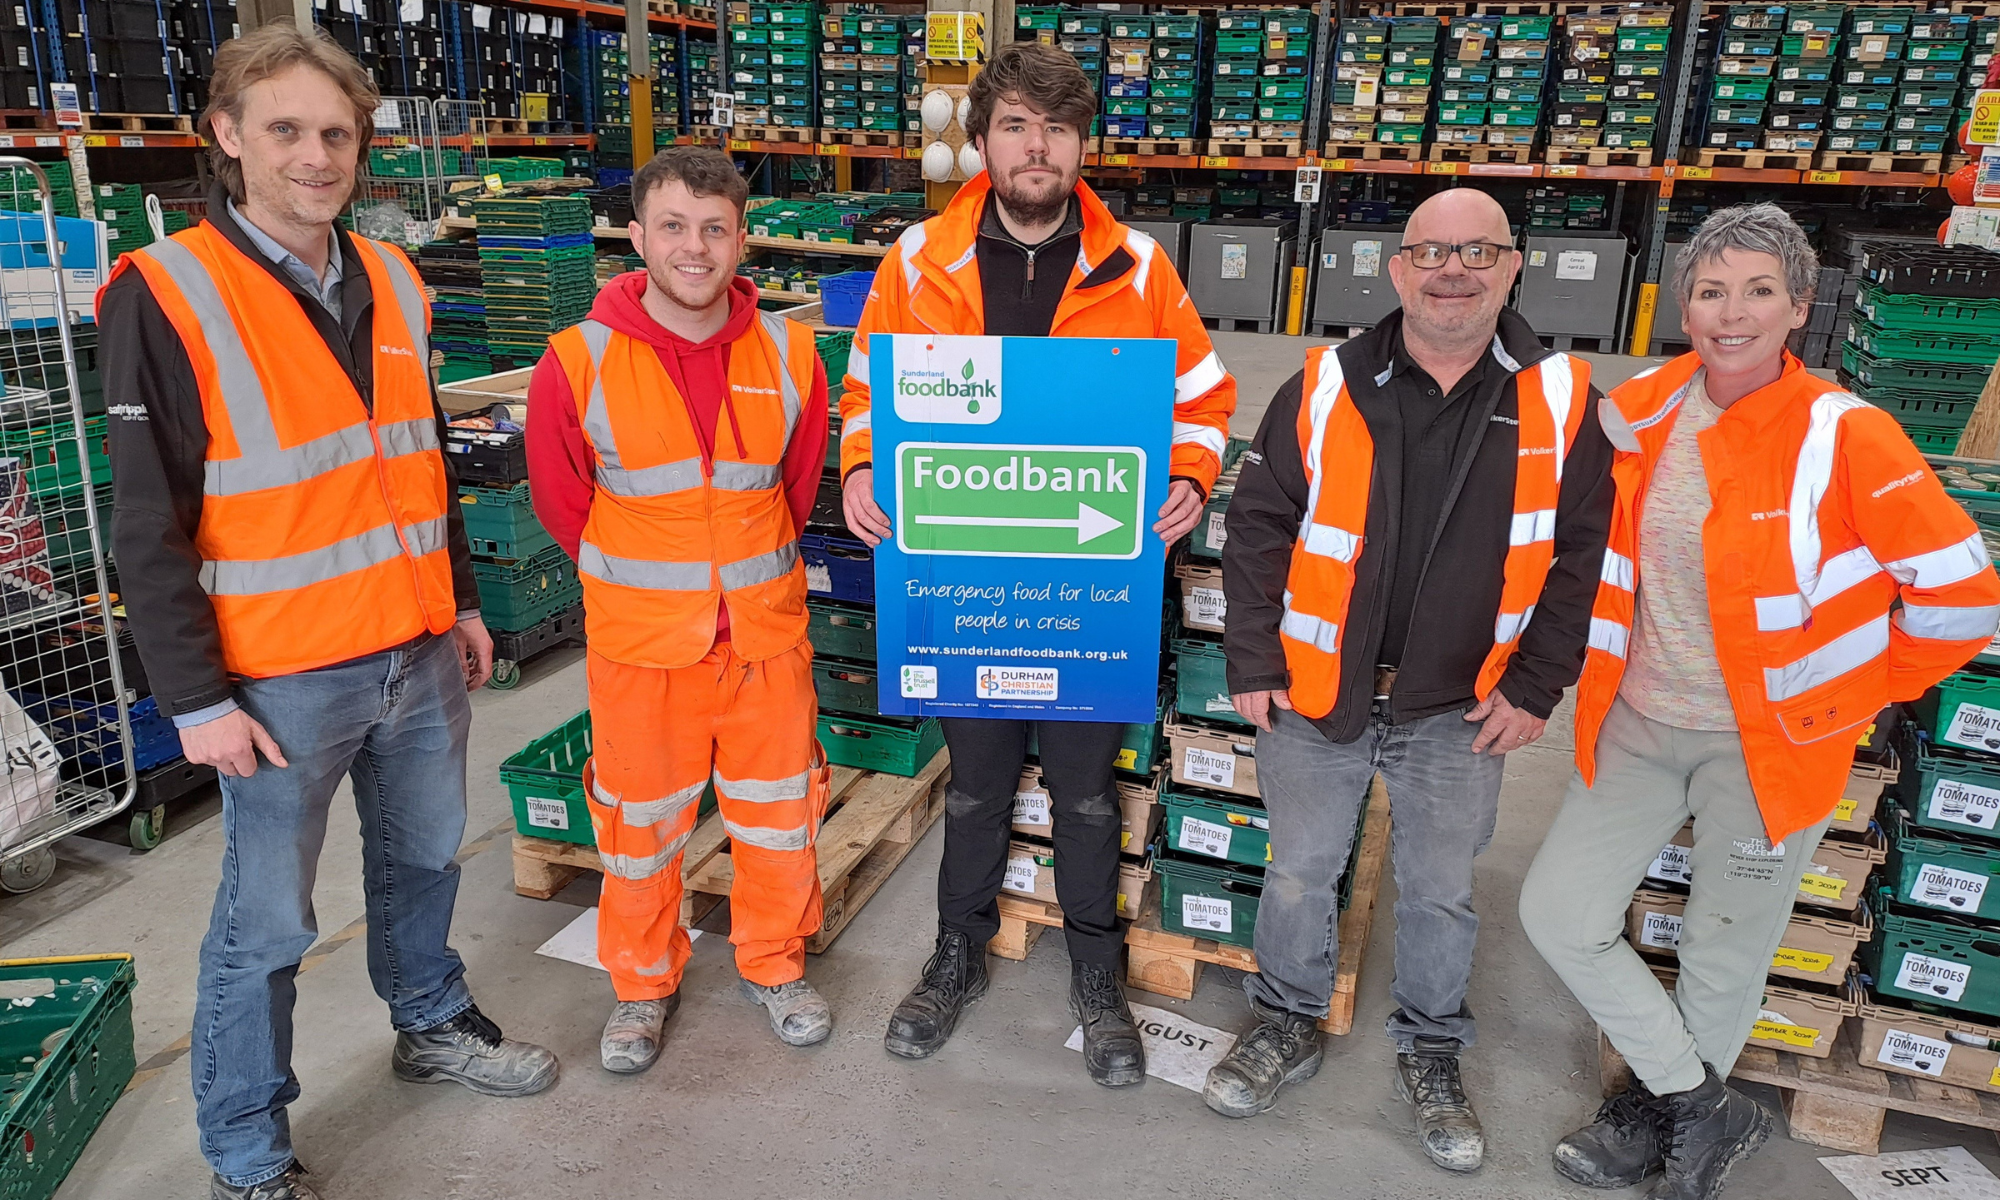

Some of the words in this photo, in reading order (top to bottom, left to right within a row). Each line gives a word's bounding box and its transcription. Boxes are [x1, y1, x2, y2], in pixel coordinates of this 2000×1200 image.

[901, 369, 945, 378] Sunderland
[898, 377, 997, 398] foodbank
[913, 455, 1129, 493] Foodbank
[904, 579, 1005, 607] Emergency
[1012, 581, 1053, 601] food
[1058, 582, 1083, 602] for
[1090, 583, 1131, 603] local
[954, 611, 1009, 635] people
[1015, 613, 1031, 629] in
[1037, 614, 1081, 631] crisis
[907, 644, 1129, 662] www.sunderlandfoodbank.org.uk
[1001, 671, 1054, 681] DURHAM
[1001, 680, 1054, 689] CHRISTIAN
[1001, 688, 1054, 696] PARTNERSHIP
[1186, 753, 1232, 771] TOMATOES
[1937, 786, 2000, 809] TOMATOES
[528, 802, 565, 814] TOMATOES
[1183, 822, 1228, 842] TOMATOES
[1742, 848, 1768, 857] FACE
[1921, 871, 1983, 894] TOMATOES
[1184, 901, 1229, 916] TOMATOES
[1905, 960, 1965, 983] TOMATOES
[1887, 1037, 1946, 1059] TOMATOES
[1881, 1166, 1950, 1187] SEPT
